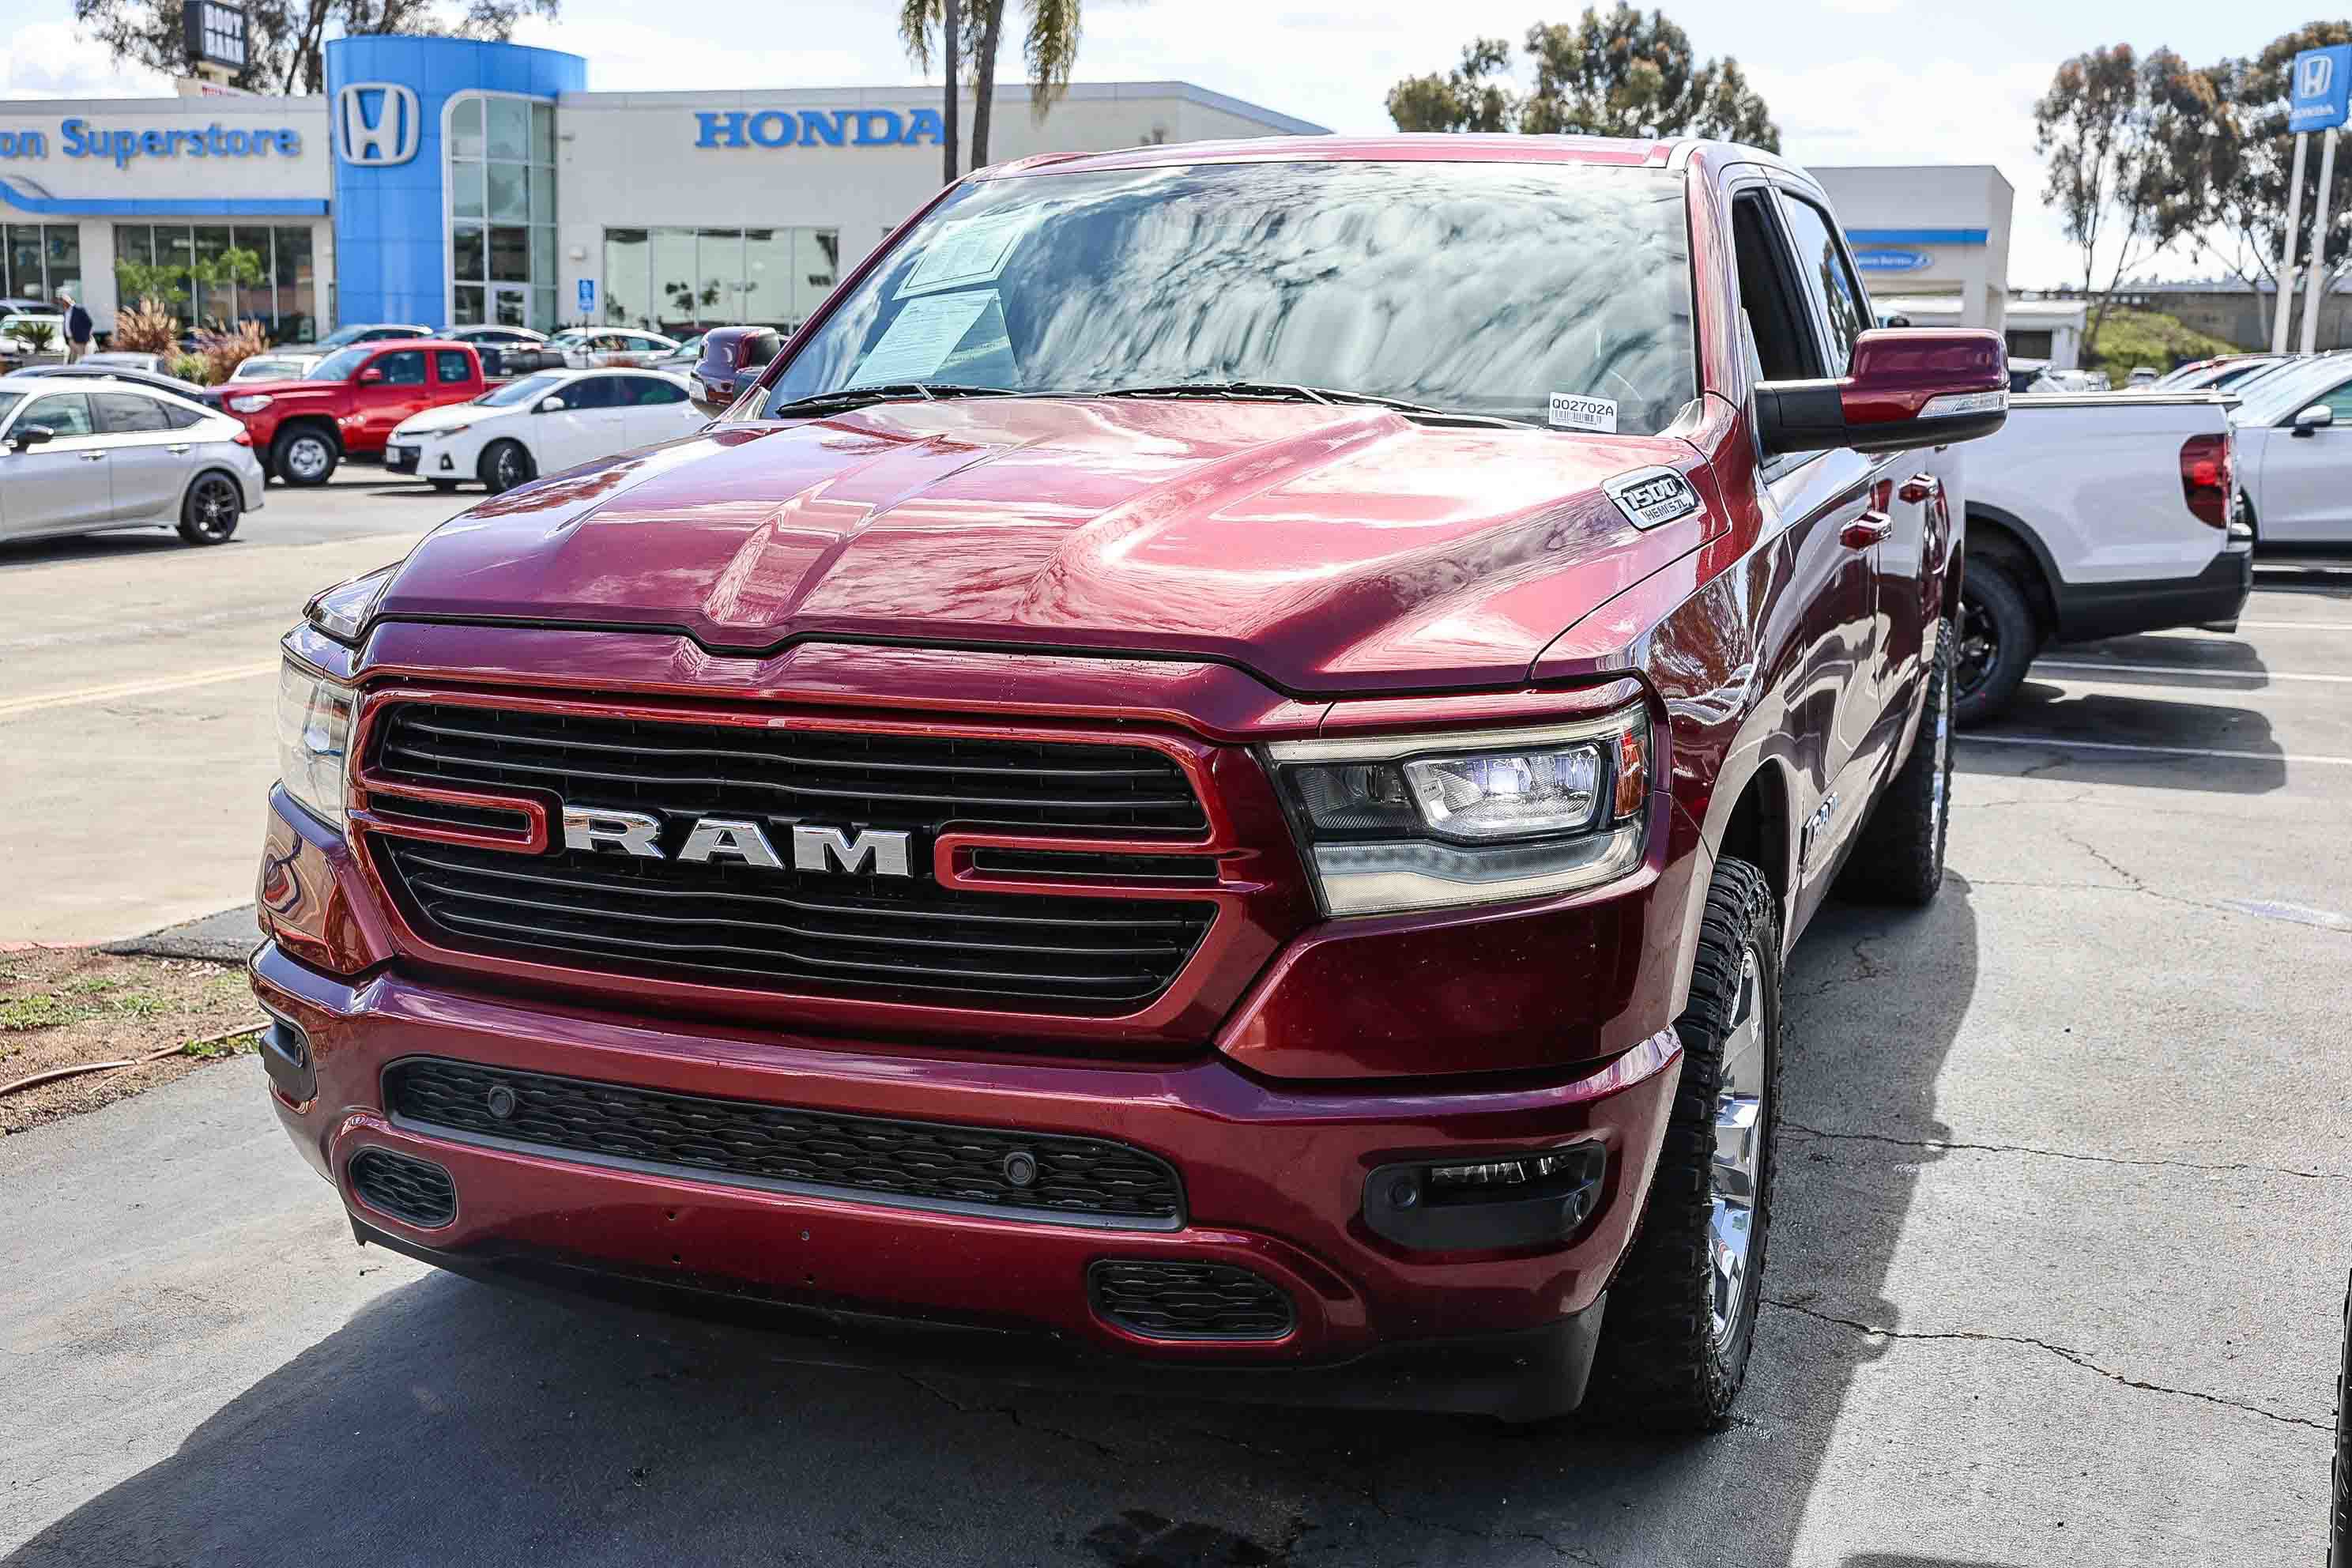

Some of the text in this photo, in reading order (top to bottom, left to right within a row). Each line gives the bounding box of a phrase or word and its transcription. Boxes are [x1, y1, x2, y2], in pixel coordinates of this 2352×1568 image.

[61, 118, 300, 167] Superstore
[695, 109, 946, 148] HONDA
[1552, 398, 1614, 416] Q02702A
[1622, 477, 1677, 509] 1500
[563, 804, 913, 877] RAM
